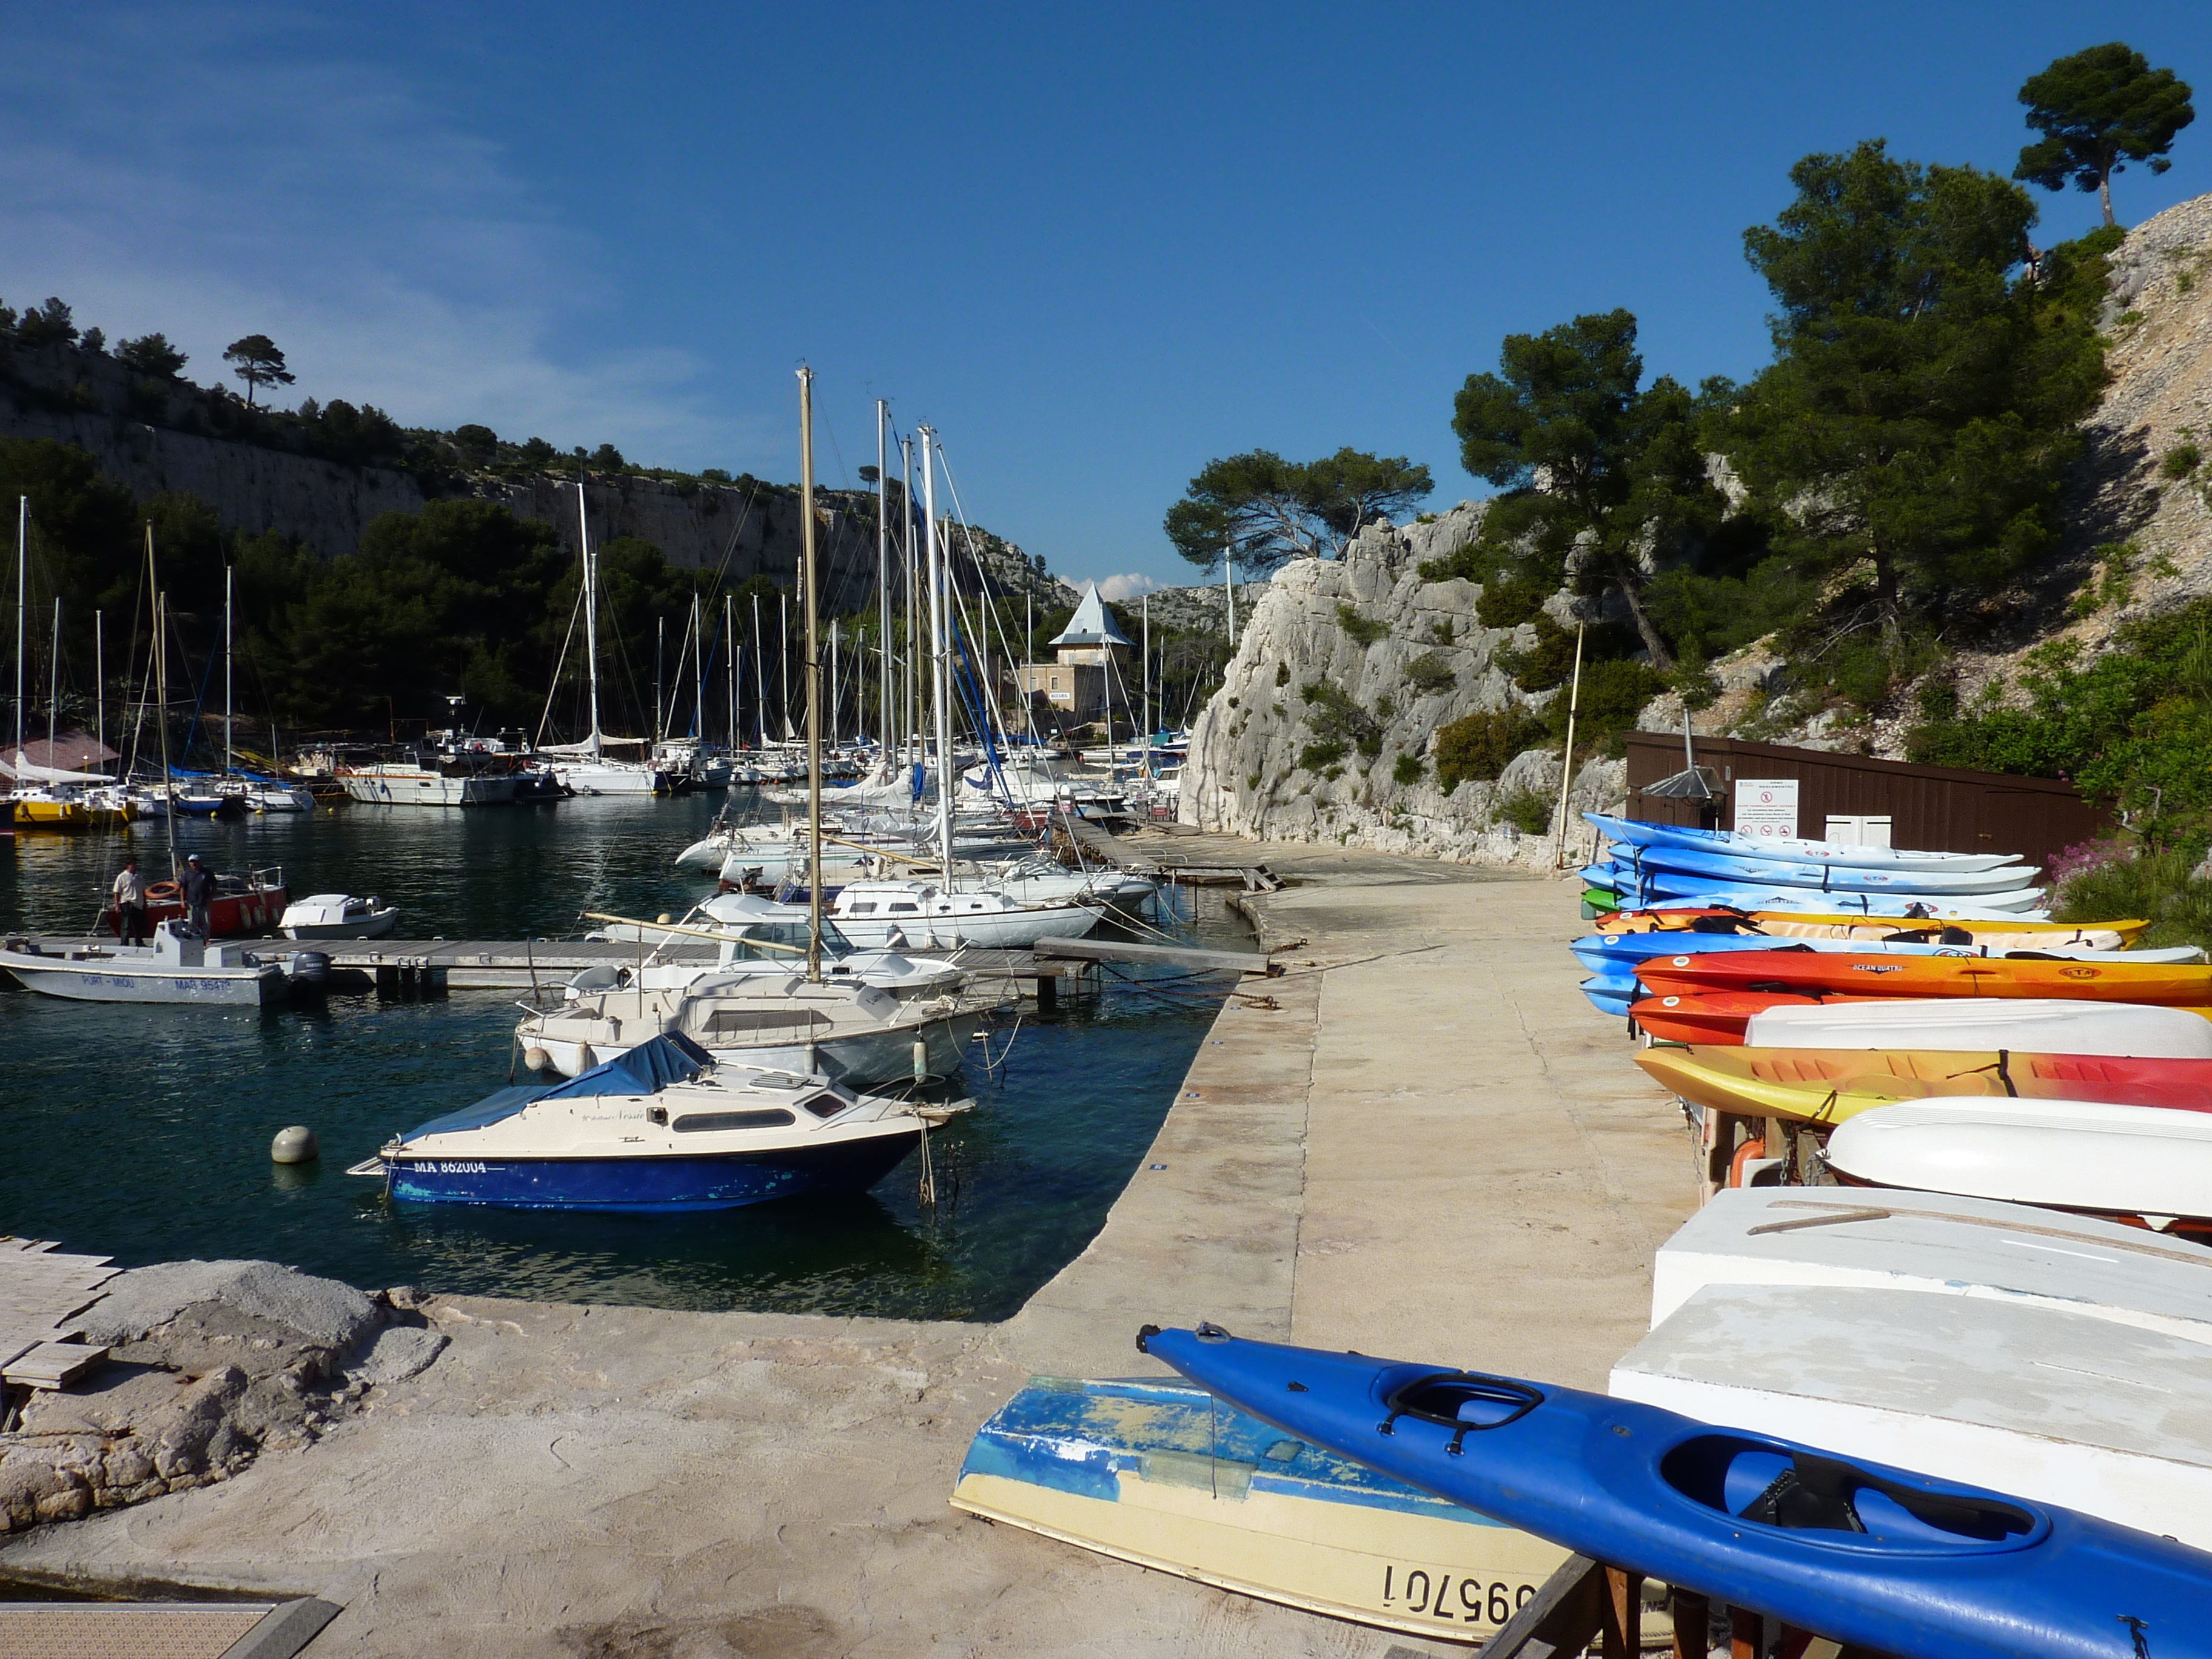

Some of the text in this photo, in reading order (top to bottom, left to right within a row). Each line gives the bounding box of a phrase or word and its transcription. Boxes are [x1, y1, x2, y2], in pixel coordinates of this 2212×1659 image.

[82, 975, 103, 985] PORT
[113, 977, 135, 988] MIOU
[414, 1161, 487, 1173] MA 862004
